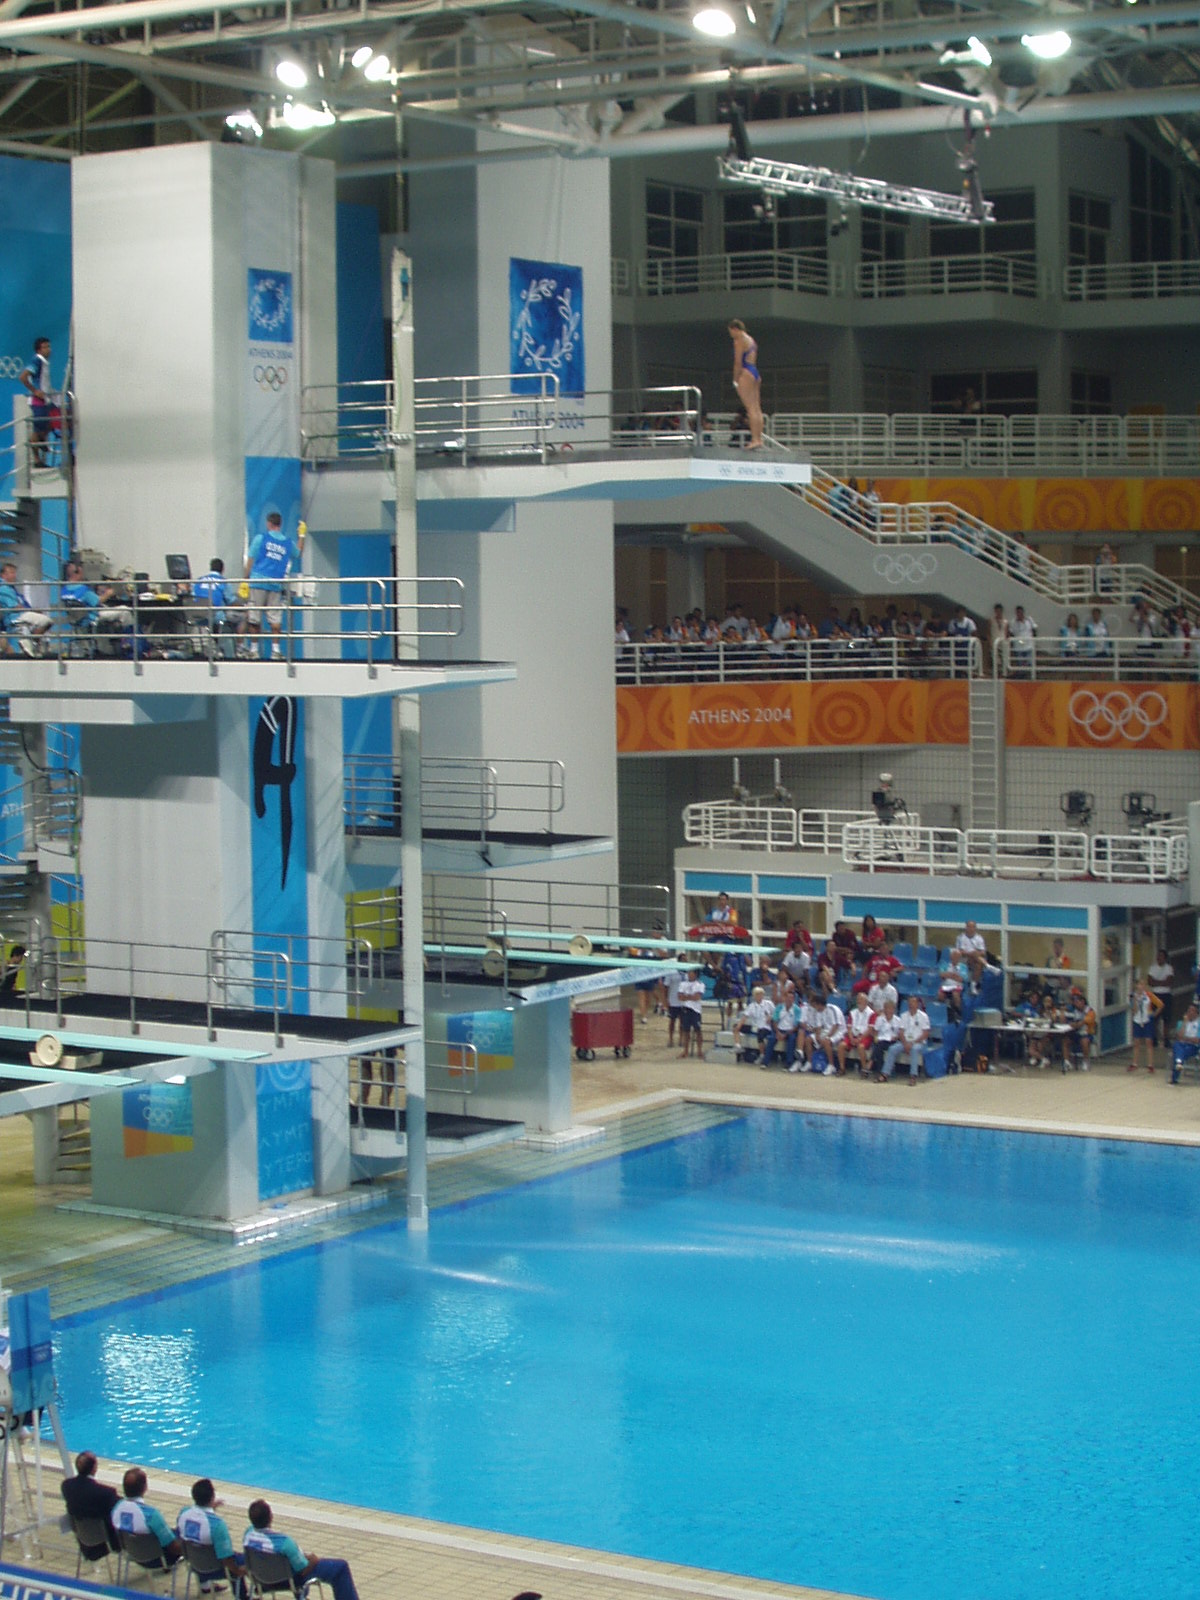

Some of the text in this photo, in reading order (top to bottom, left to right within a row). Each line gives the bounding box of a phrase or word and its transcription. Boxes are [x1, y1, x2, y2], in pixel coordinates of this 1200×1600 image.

[511, 409, 555, 428] ATHES
[687, 707, 792, 724] ATHENS 2004
